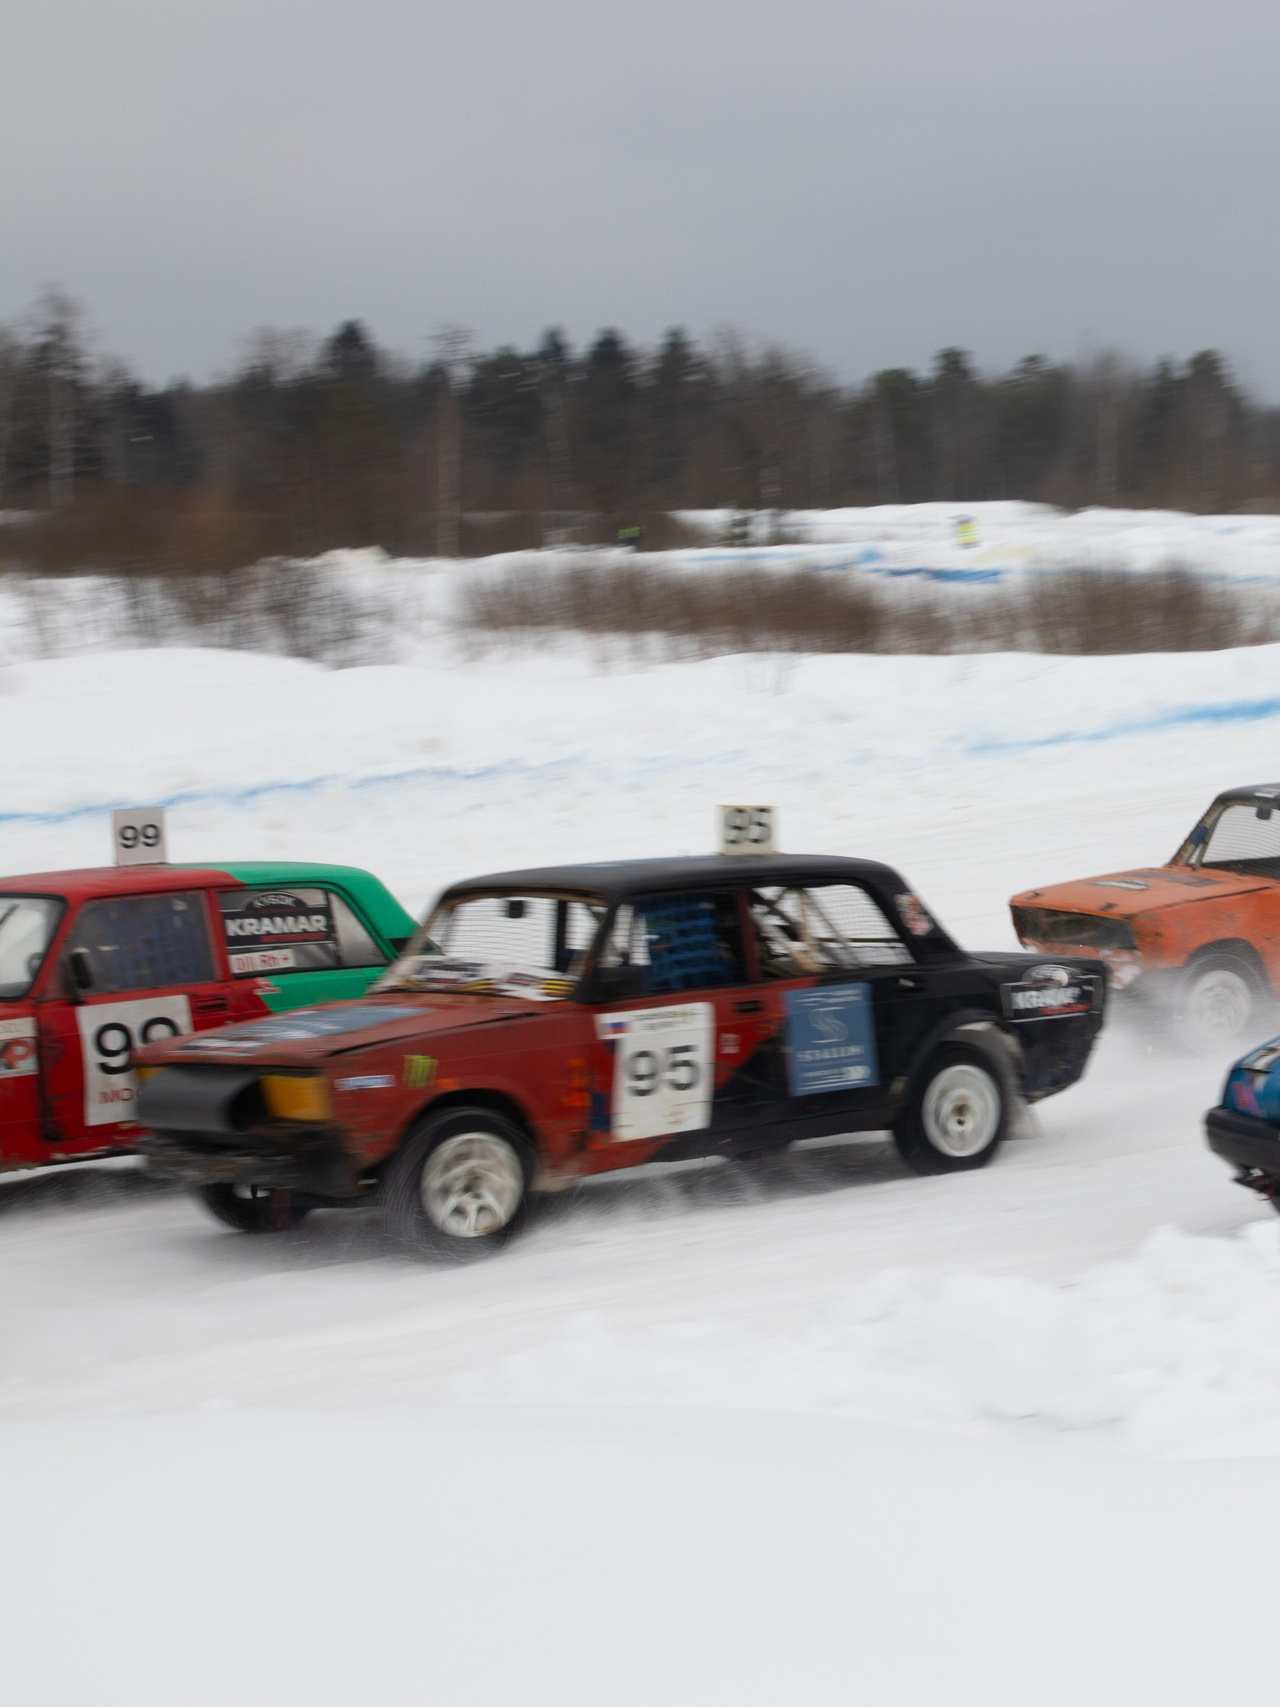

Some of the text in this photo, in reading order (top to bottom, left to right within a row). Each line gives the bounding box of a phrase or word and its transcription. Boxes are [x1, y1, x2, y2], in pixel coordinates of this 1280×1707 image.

[119, 824, 161, 849] 99
[225, 915, 328, 936] KRAMAR
[624, 1045, 701, 1096] 95
